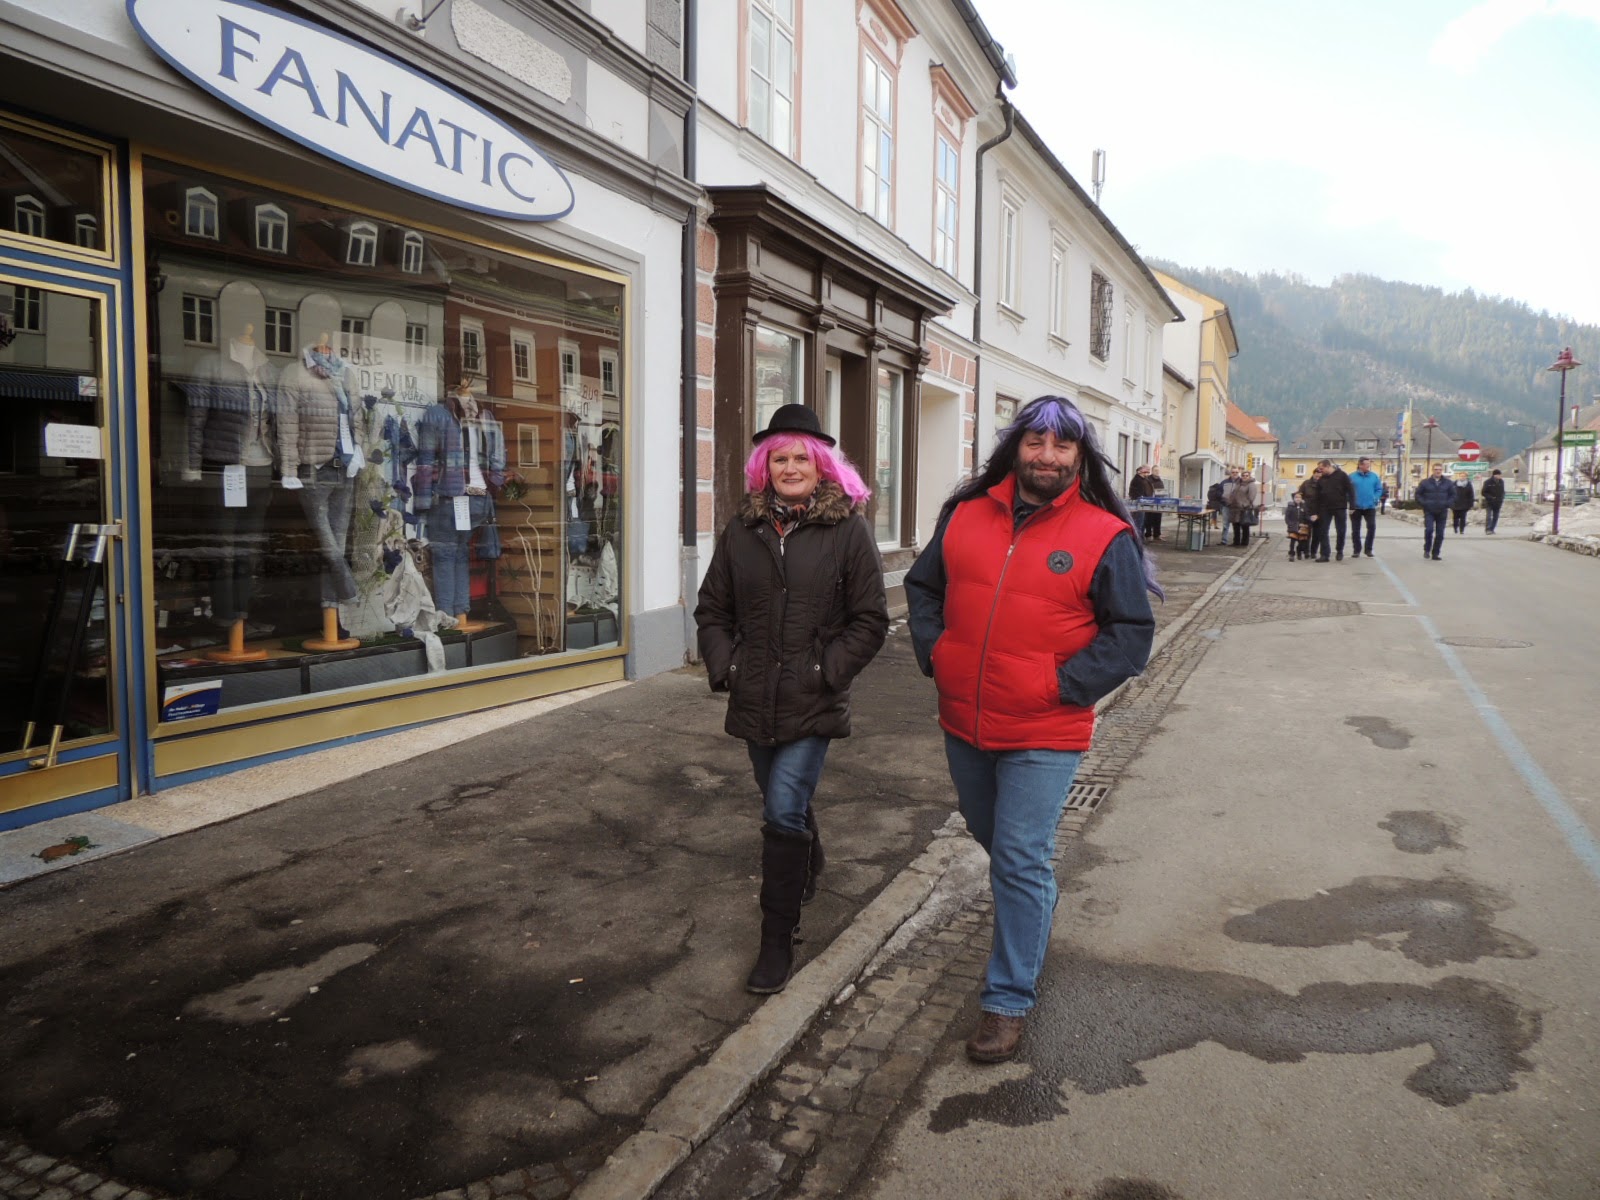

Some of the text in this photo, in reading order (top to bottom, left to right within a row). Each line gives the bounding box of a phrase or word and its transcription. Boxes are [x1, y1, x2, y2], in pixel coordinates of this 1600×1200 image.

[217, 14, 536, 204] FANATIC
[340, 347, 383, 366] PURE
[360, 370, 418, 391] DENIM
